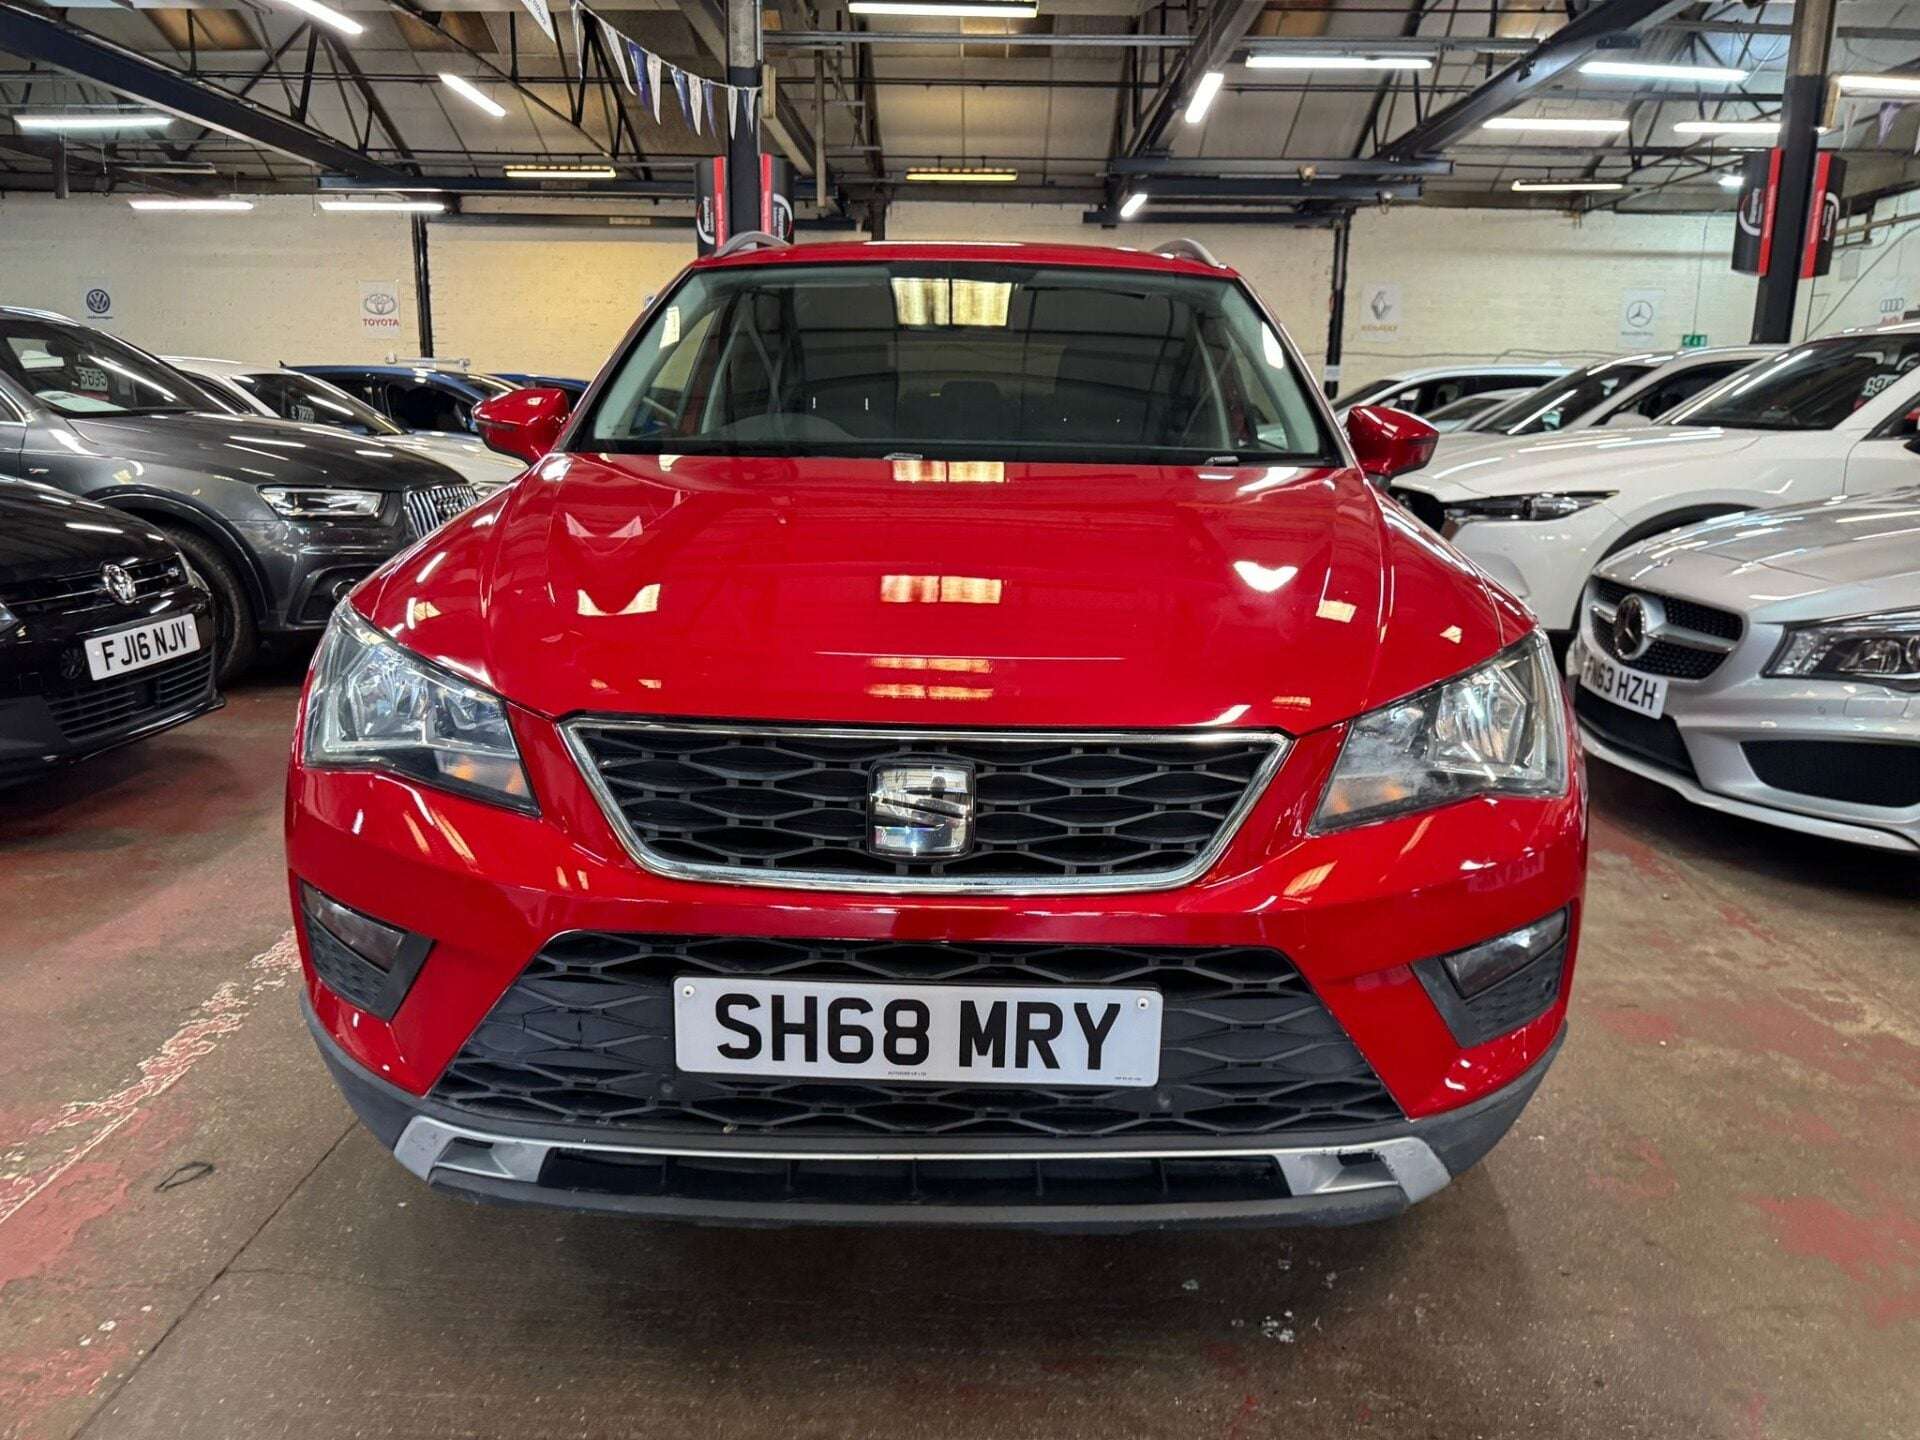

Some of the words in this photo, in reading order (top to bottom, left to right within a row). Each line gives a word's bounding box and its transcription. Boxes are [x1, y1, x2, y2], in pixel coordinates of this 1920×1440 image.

[362, 318, 399, 327] TOYOTA
[101, 632, 151, 671] FJ16
[153, 621, 187, 656] NJV
[1616, 671, 1657, 710] HZH
[714, 992, 931, 1066] SH68
[958, 1000, 1122, 1071] MRY
